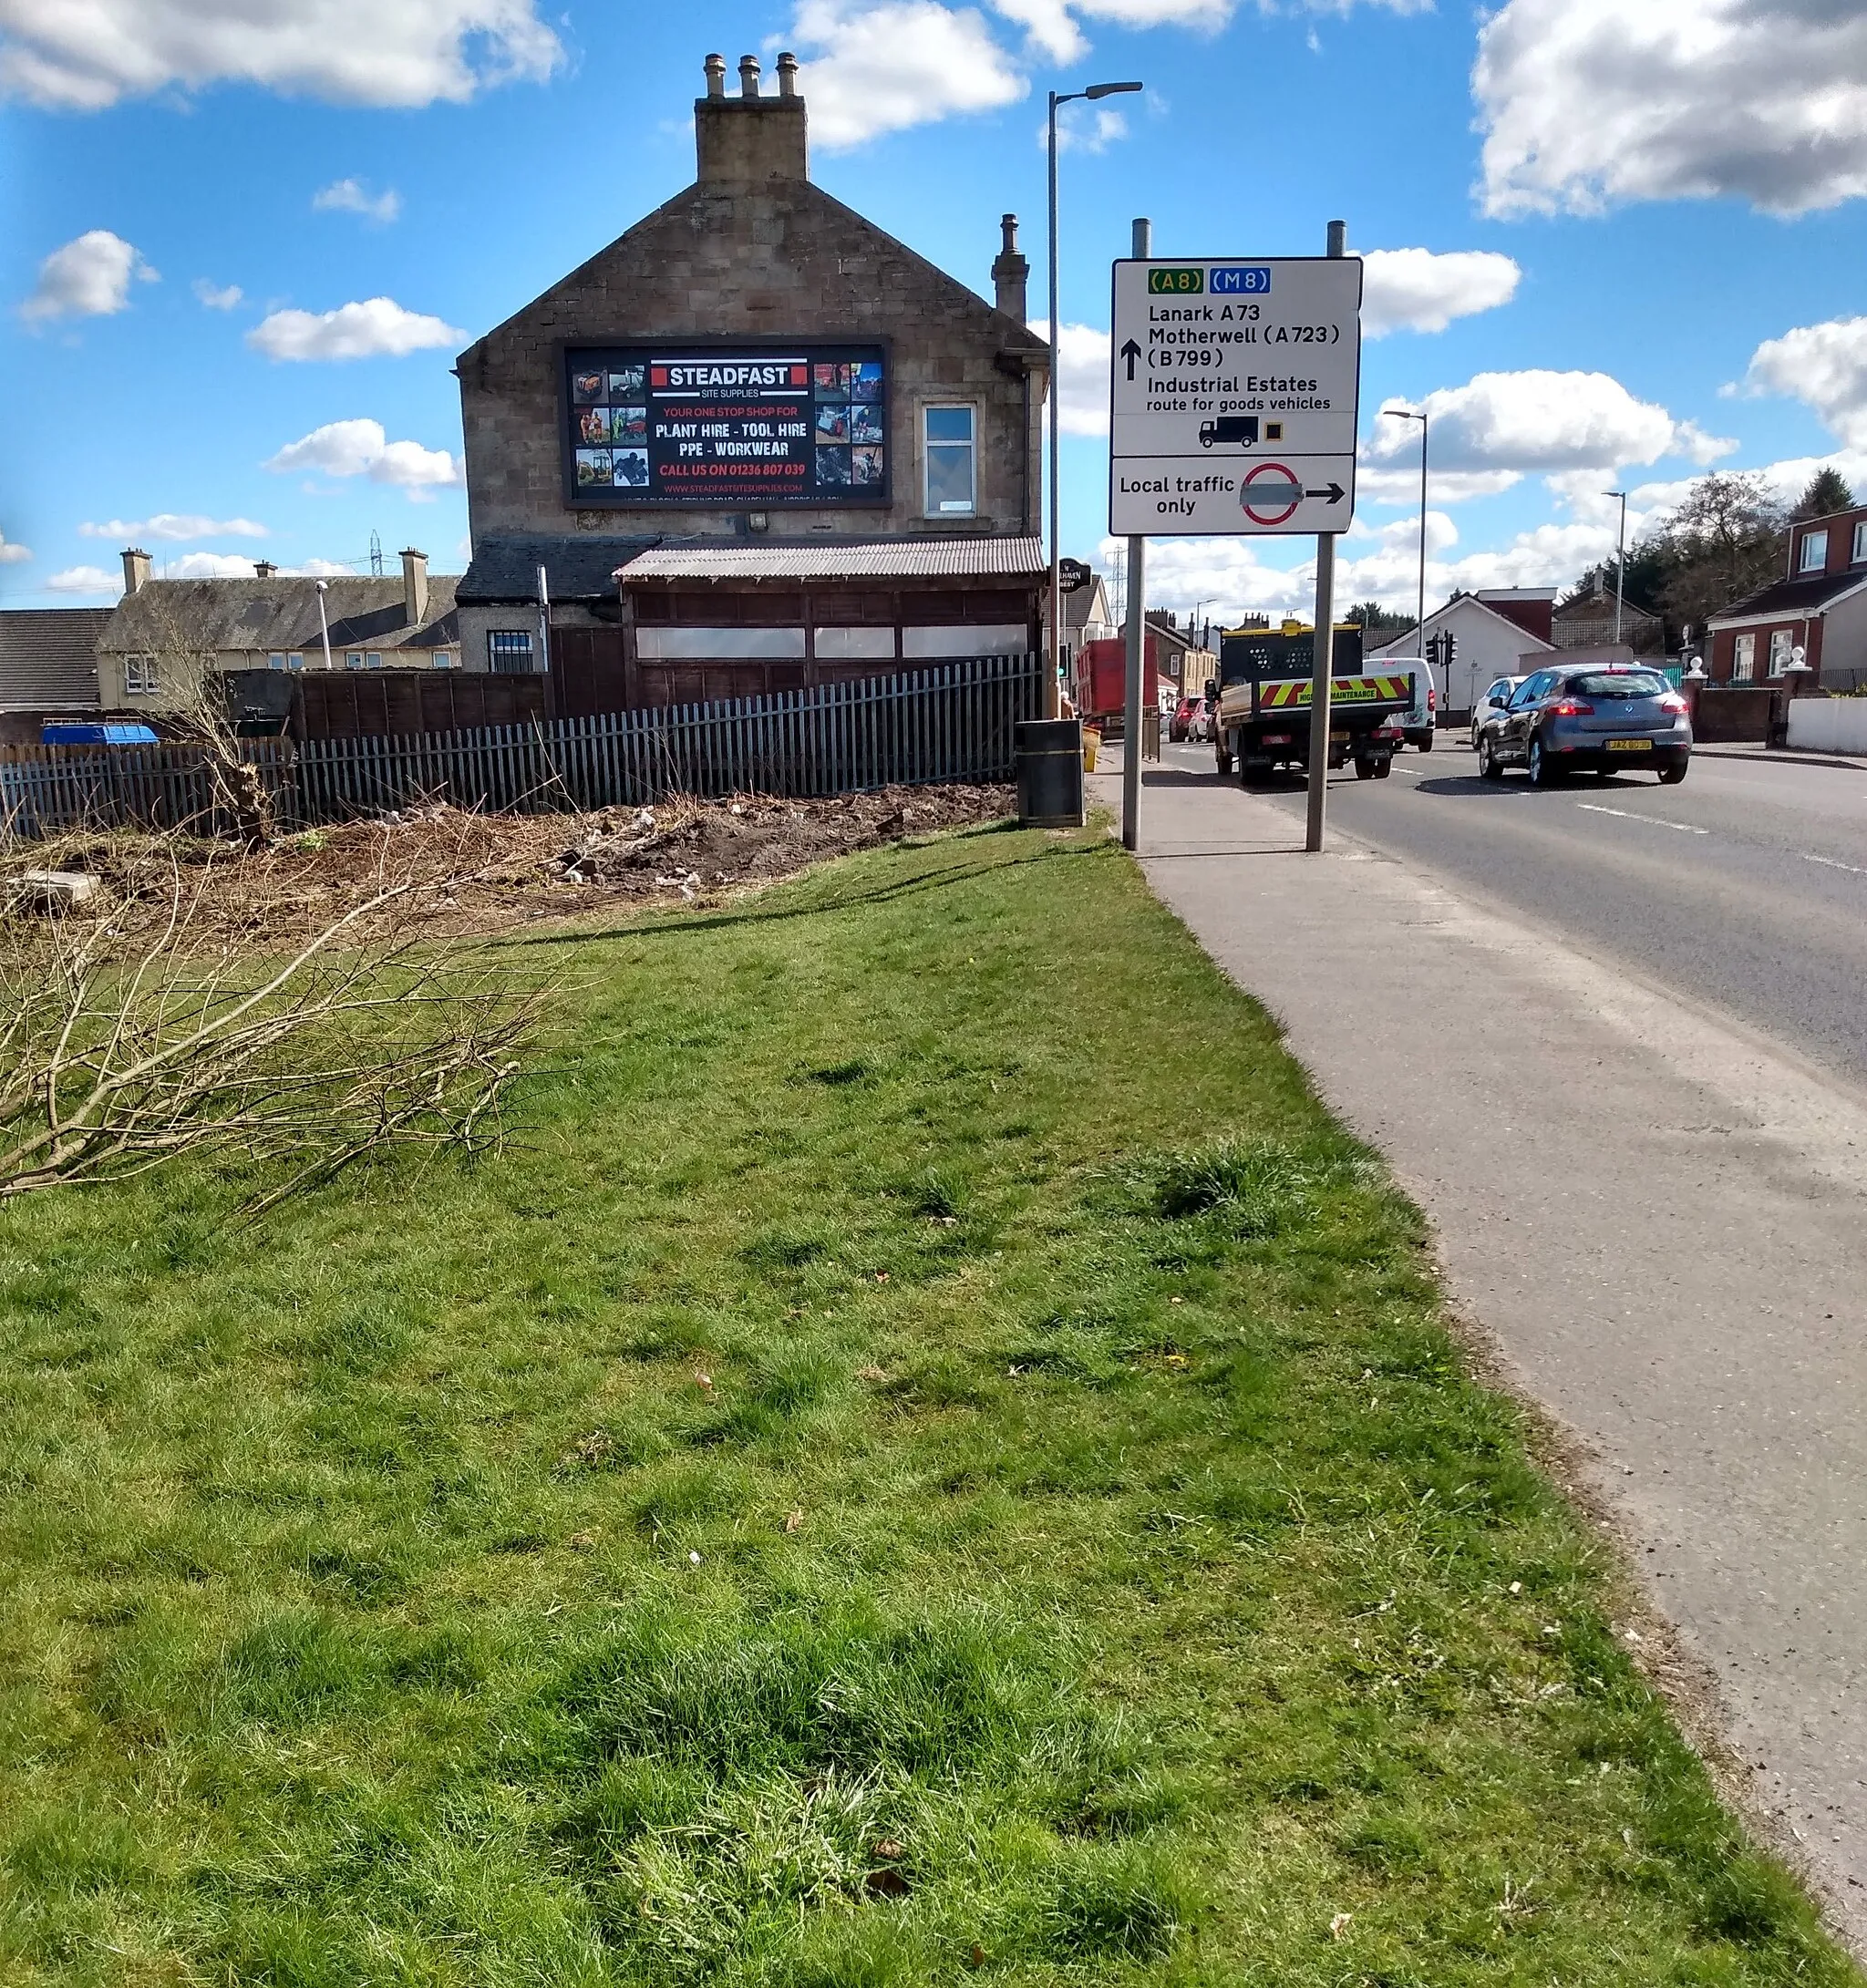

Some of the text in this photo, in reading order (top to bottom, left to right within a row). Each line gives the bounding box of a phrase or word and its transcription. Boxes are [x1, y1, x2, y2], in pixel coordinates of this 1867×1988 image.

[1151, 270, 1267, 292] (A8) (M8)
[1150, 304, 1260, 322] Lanark A73
[1149, 324, 1340, 345] Motherwell (A723)
[1148, 348, 1223, 368] (B799)
[670, 366, 789, 386] STEADFAST
[1148, 376, 1317, 393] Industrial Estates
[701, 388, 758, 398] SITE SUPPLIES
[664, 407, 798, 417] YOUR ONE STOP SHOP FOR
[1147, 397, 1330, 413] route for goods vehicles
[655, 424, 697, 438] PLANT
[701, 424, 729, 438] HIRE
[742, 423, 775, 438] TOOL
[779, 423, 807, 437] HIRE
[679, 442, 703, 457] PPE
[715, 441, 789, 457] WORKWEAR
[659, 464, 806, 476] CALL US ON 01236 807 039
[1119, 477, 1234, 493] Local traffic
[1157, 498, 1196, 515] only
[1331, 690, 1375, 700] MAINTENANCE
